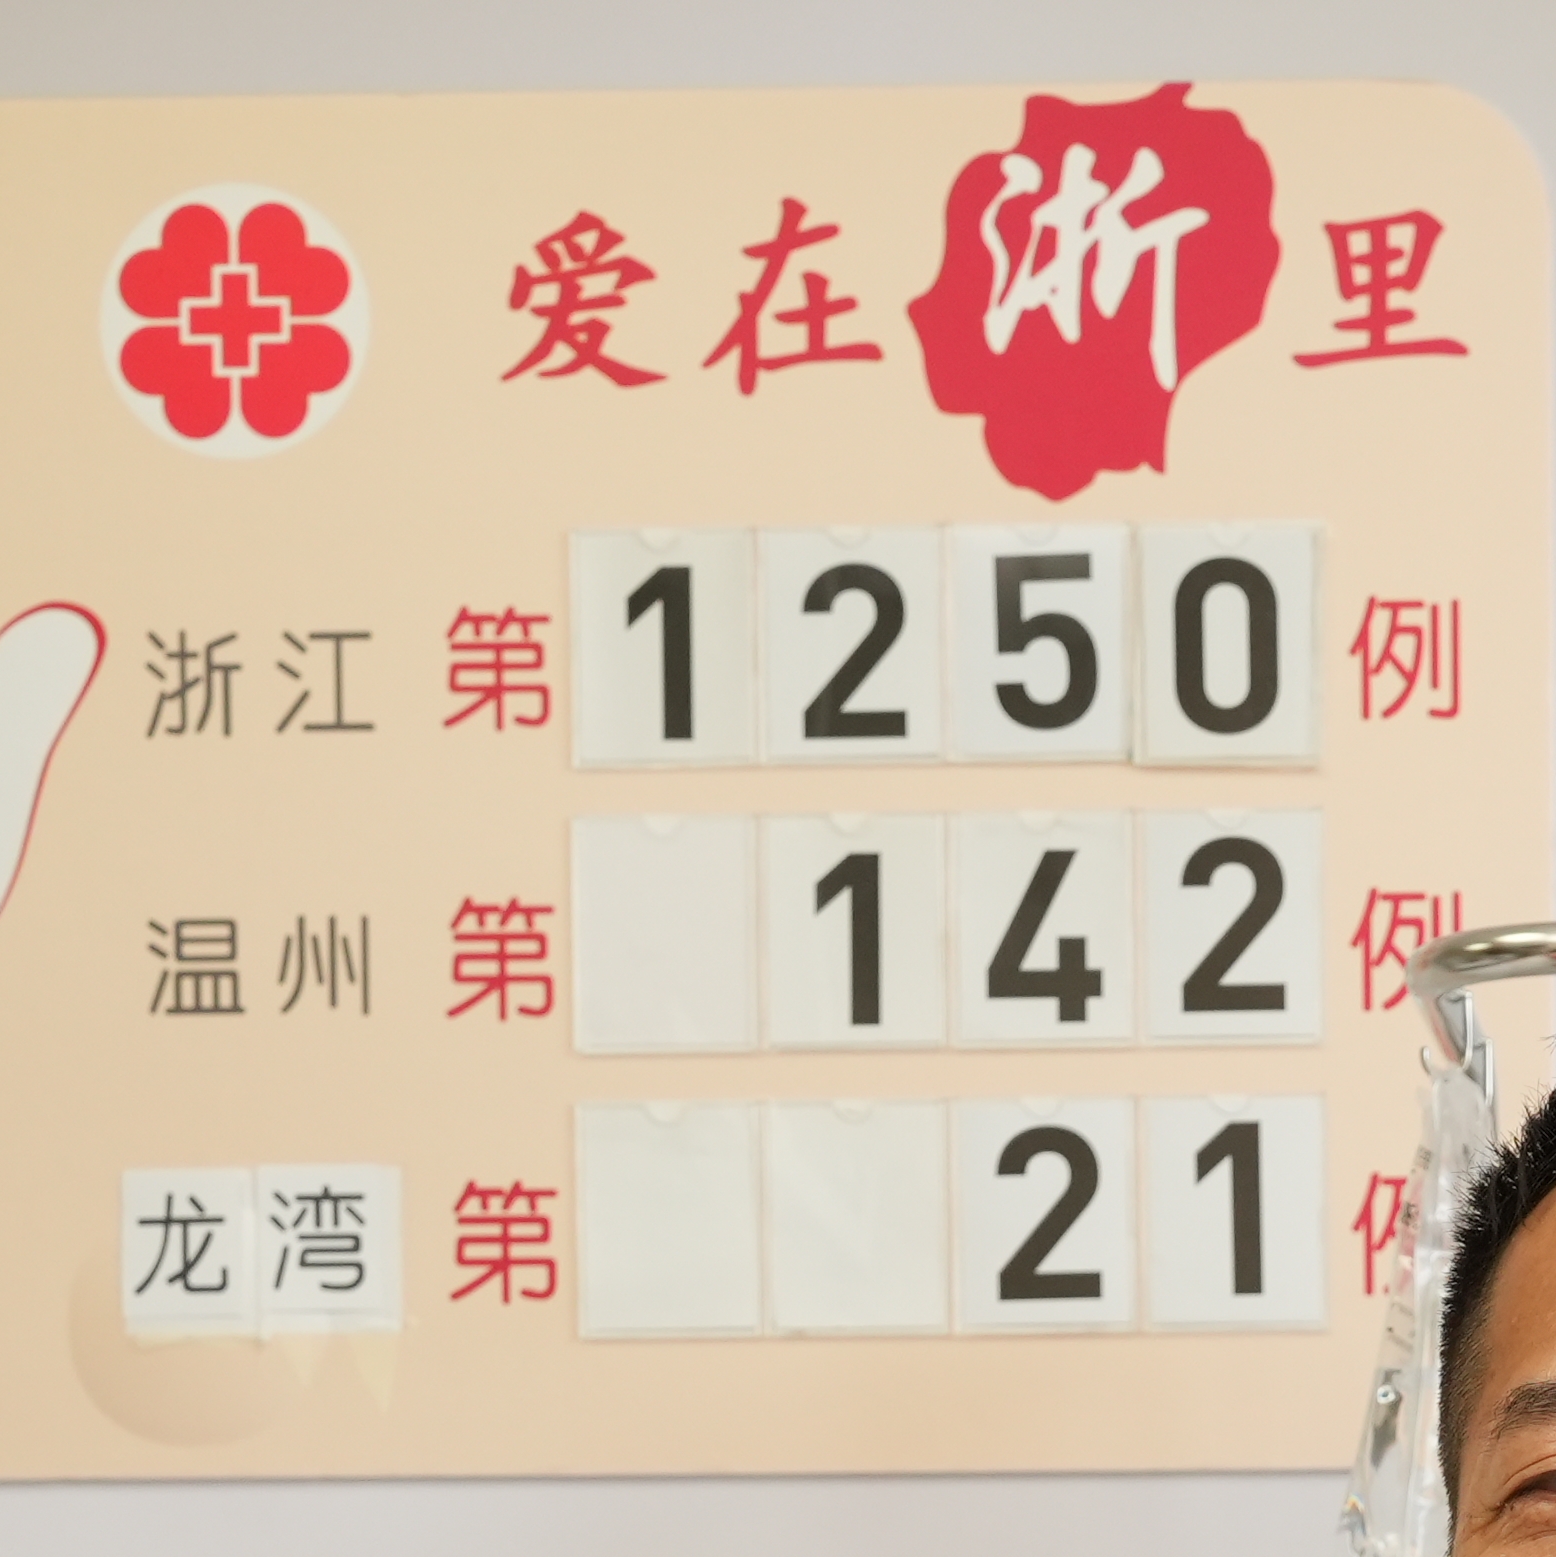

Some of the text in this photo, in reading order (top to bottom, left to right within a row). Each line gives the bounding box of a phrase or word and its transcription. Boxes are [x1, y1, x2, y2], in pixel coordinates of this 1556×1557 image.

[500, 144, 1472, 397] 爱在浙里
[146, 551, 1463, 740] 浙江 第 1250 例
[147, 915, 371, 1016] 温州
[445, 895, 558, 1023] 第
[811, 837, 1285, 1025] 142
[135, 1185, 368, 1297] 龙湾
[449, 1178, 561, 1306] 第
[996, 1122, 1263, 1301] 21
